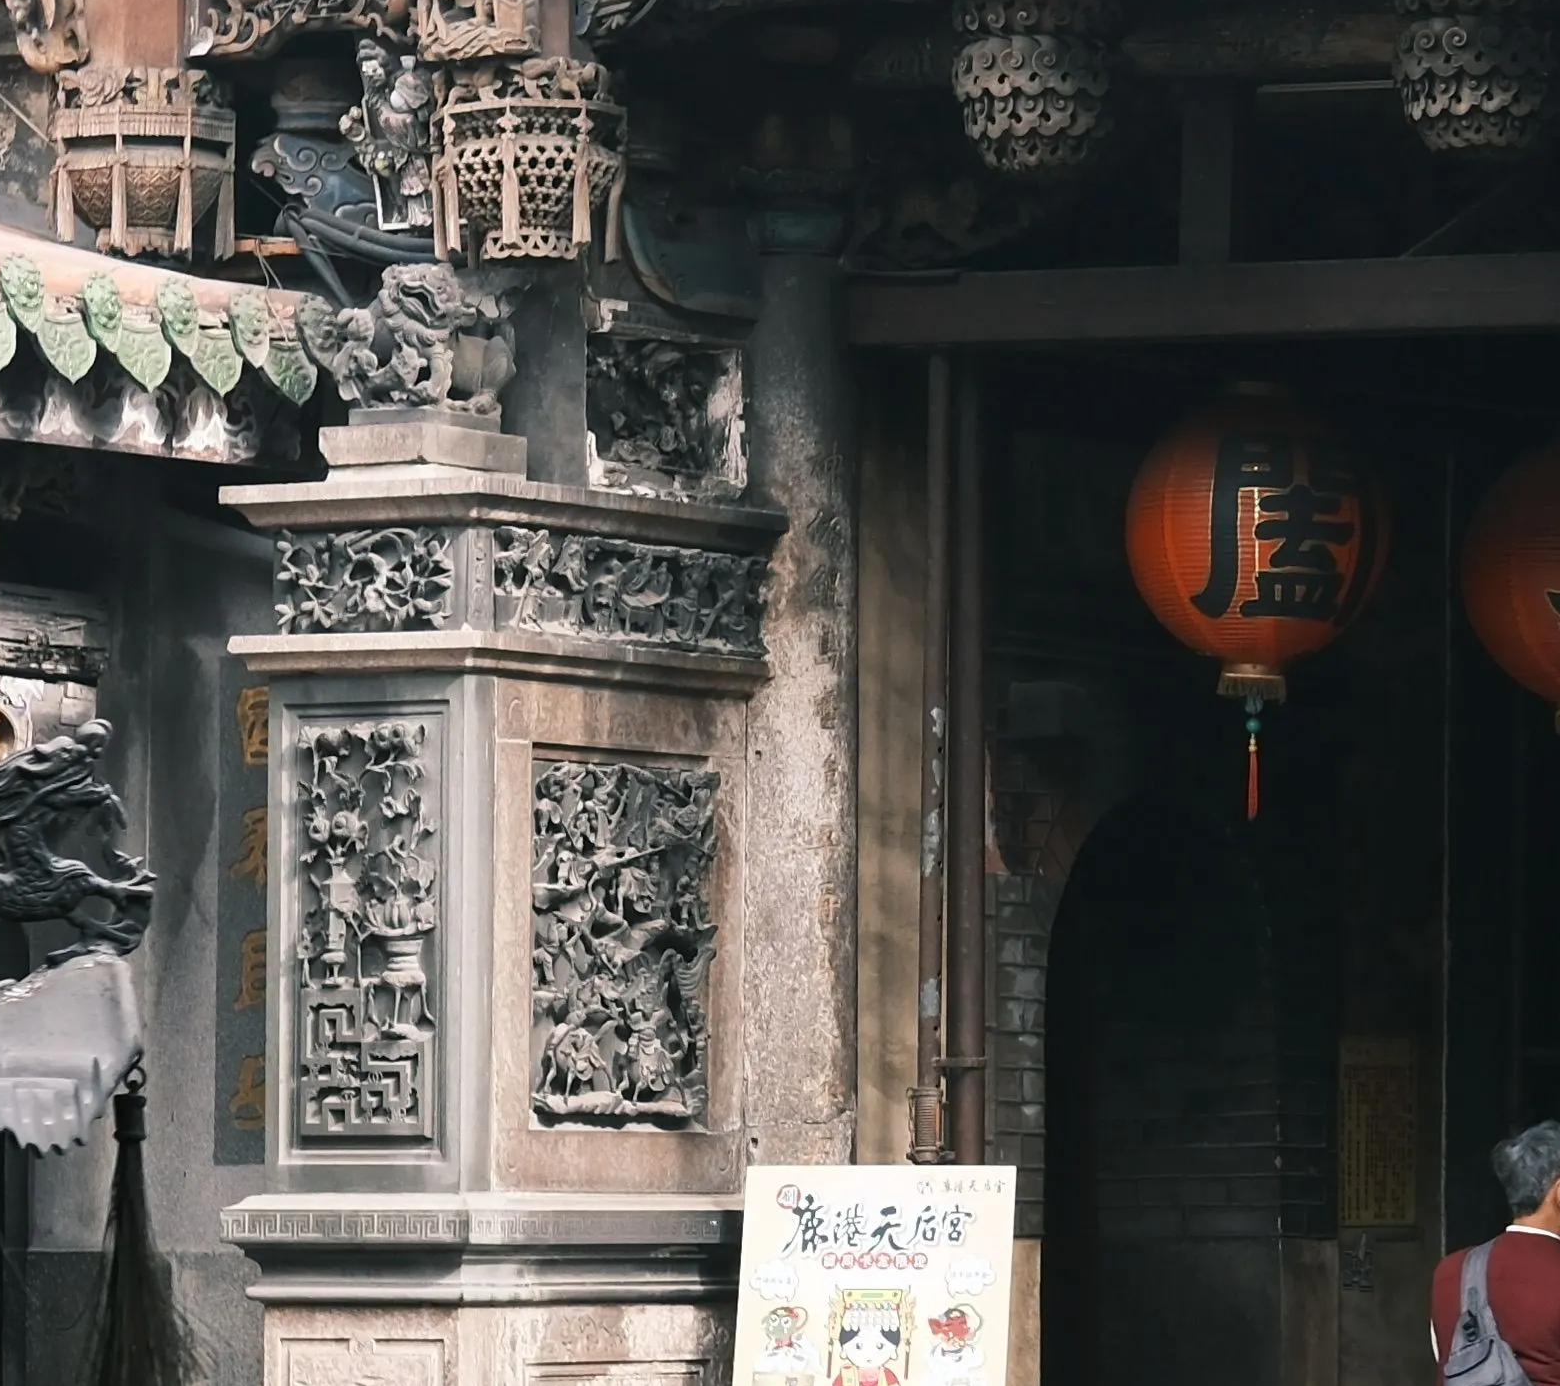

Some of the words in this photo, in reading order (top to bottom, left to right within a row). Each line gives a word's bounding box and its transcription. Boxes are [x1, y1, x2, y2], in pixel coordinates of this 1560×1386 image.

[781, 1193, 974, 1254] 鹿港天后宮
